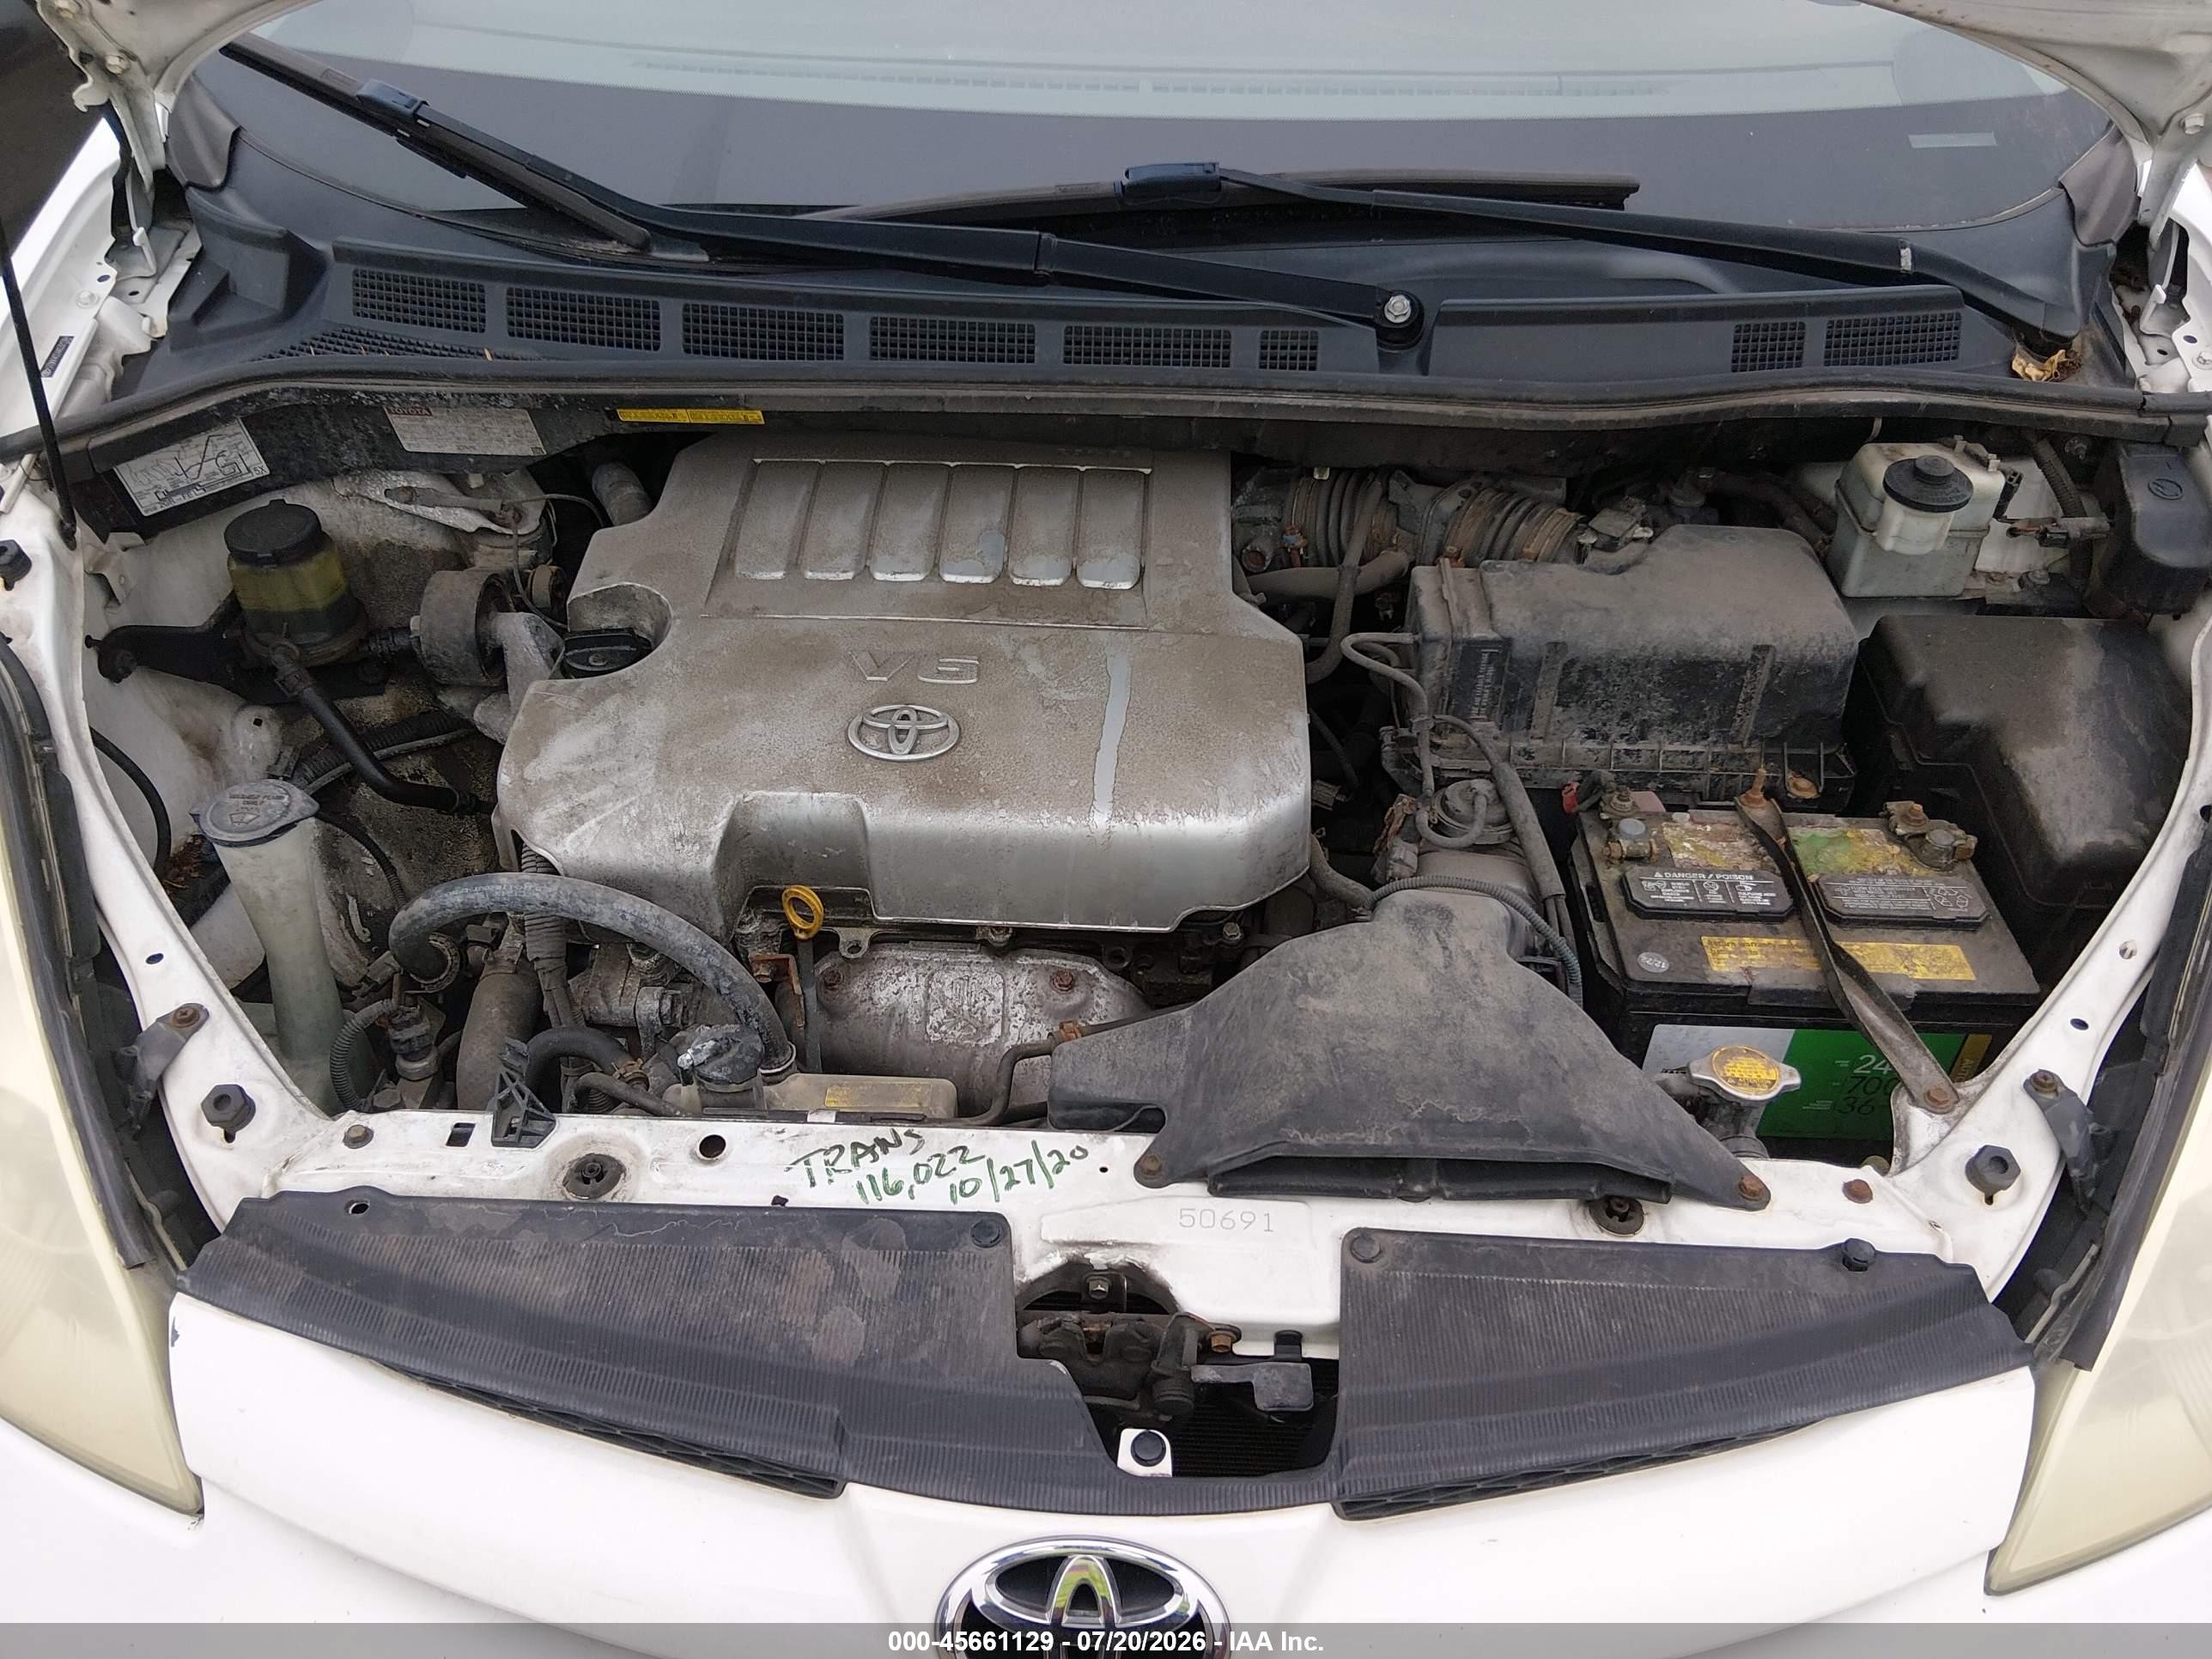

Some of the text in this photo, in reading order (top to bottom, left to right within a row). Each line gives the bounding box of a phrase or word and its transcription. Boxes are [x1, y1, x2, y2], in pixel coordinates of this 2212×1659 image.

[848, 650, 980, 684] V6
[784, 1128, 926, 1188] TRANS
[855, 1139, 1088, 1205] 116,022 10/27/20
[1179, 1208, 1274, 1232] 50691
